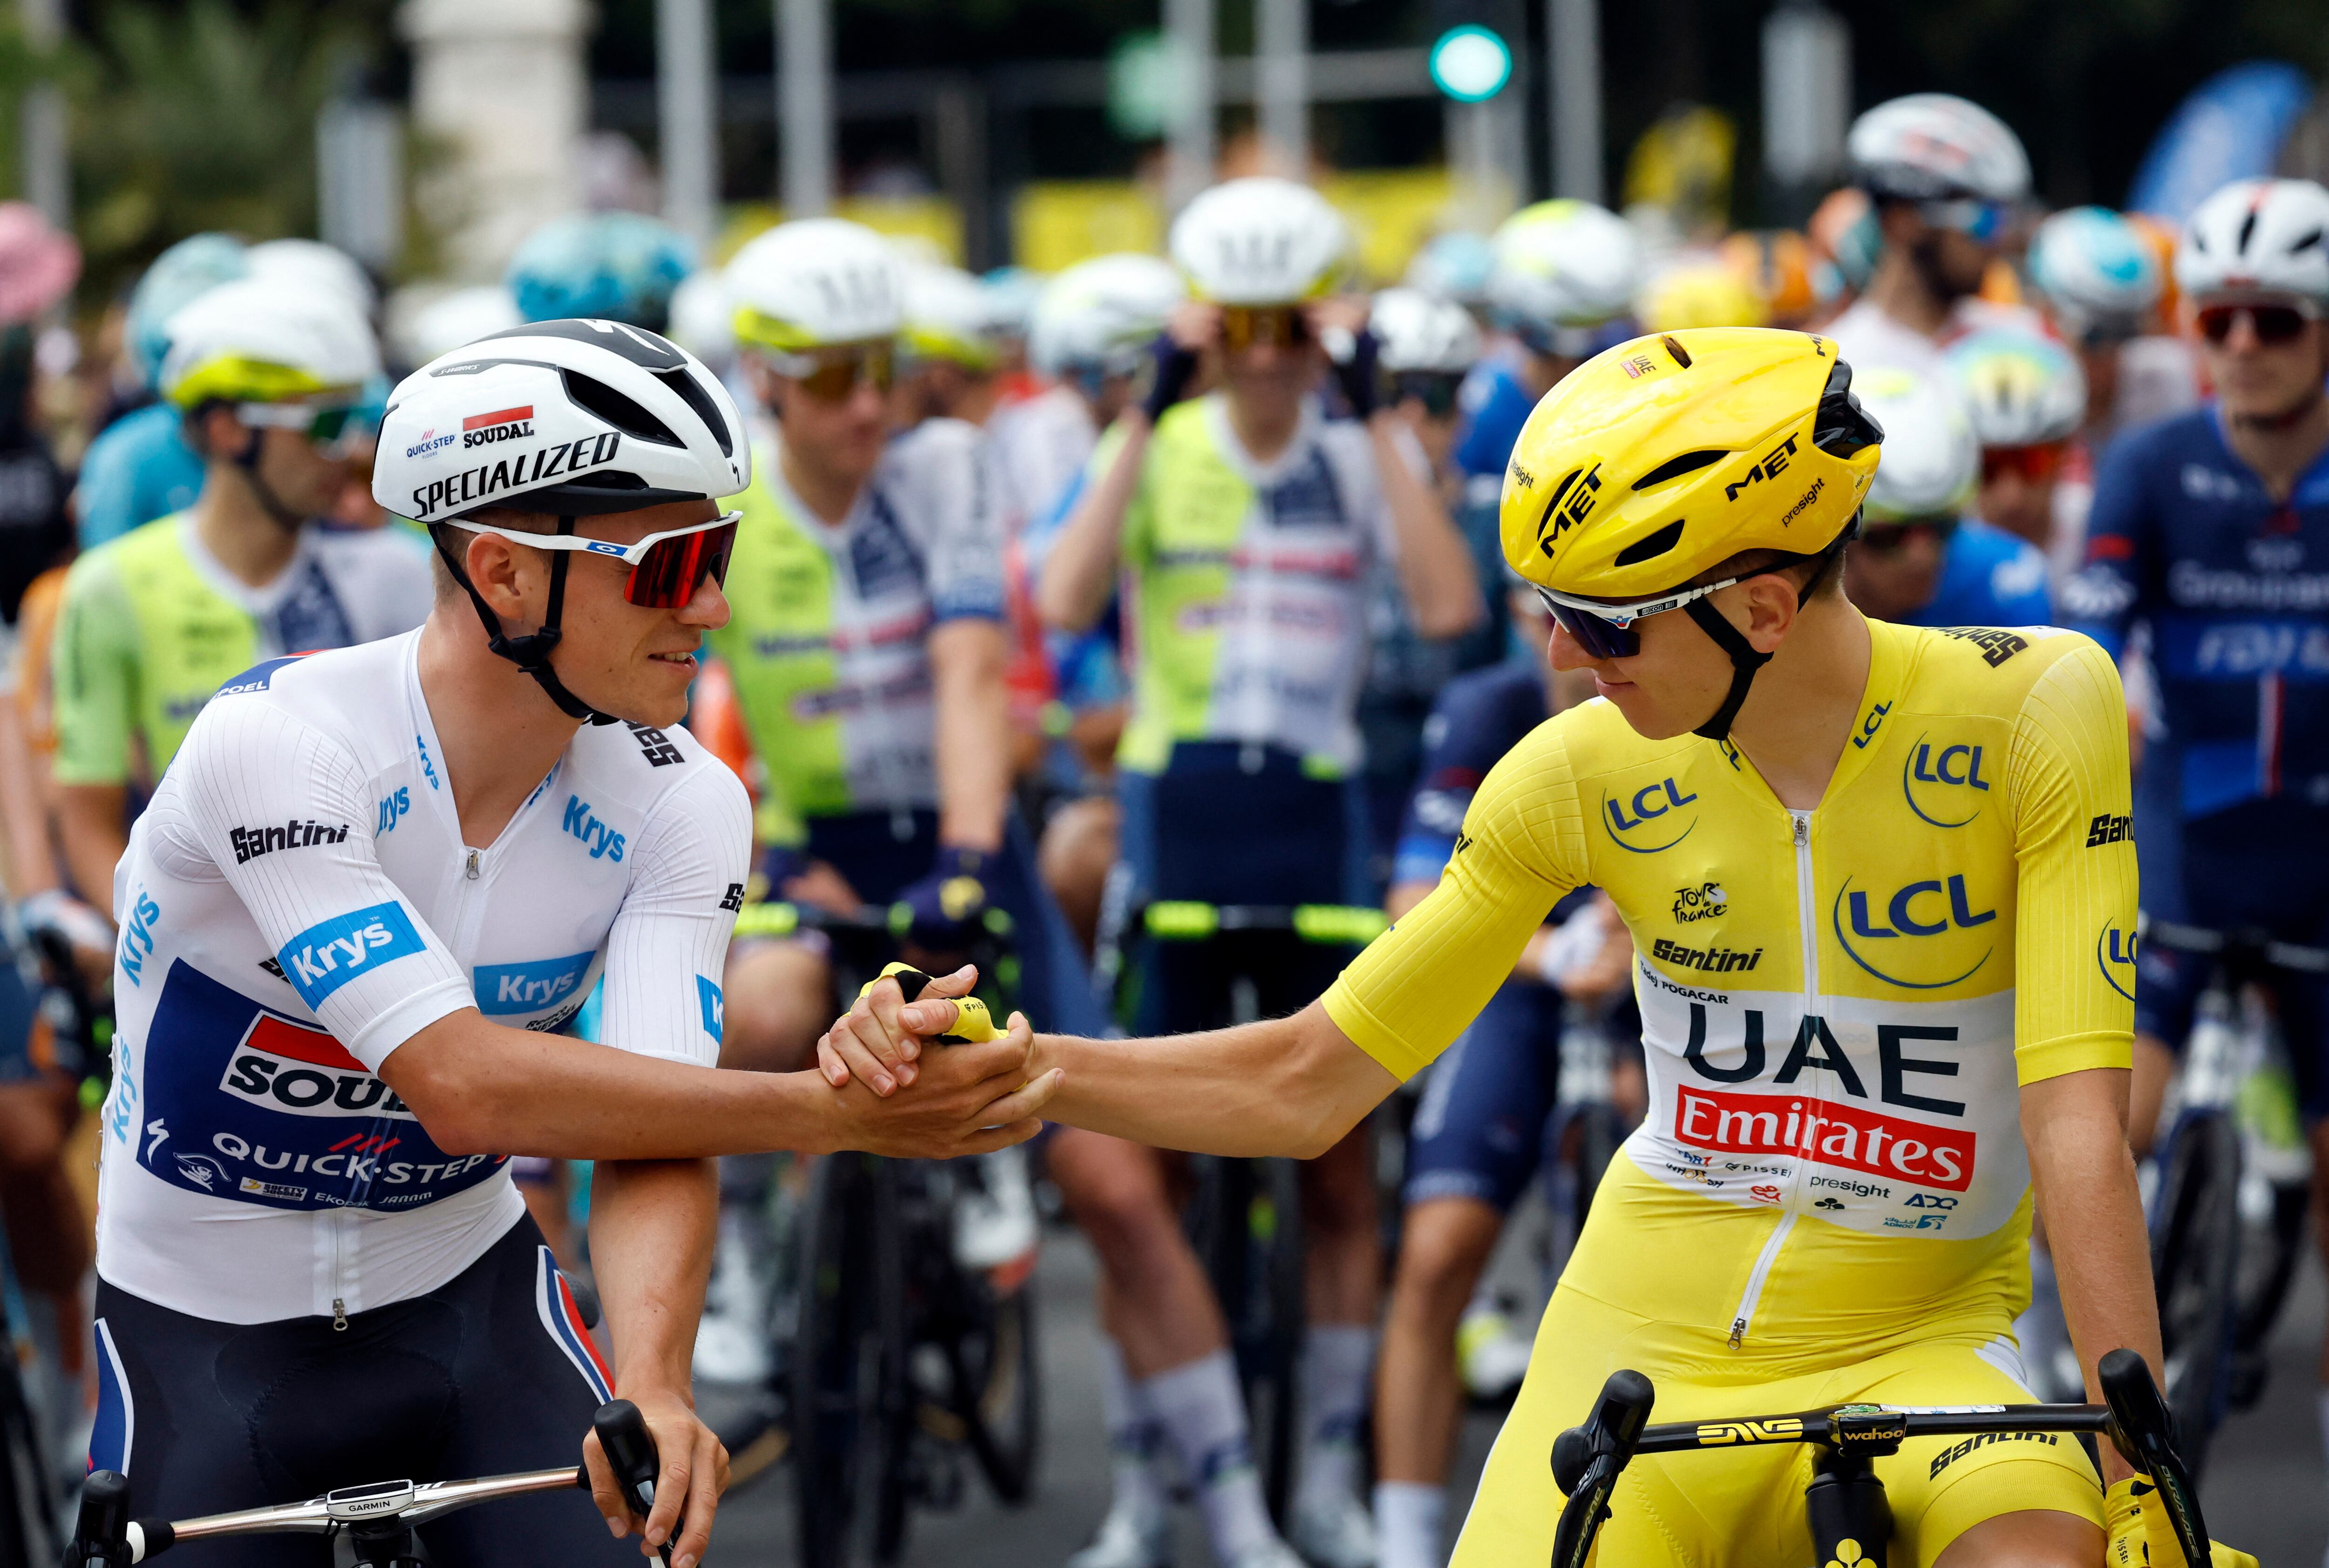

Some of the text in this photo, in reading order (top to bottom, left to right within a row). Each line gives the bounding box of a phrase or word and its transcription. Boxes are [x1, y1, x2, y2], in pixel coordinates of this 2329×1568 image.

[438, 364, 480, 375] S-WORKS
[1633, 355, 1656, 374] UAE
[463, 422, 534, 449] SOUDAL
[413, 431, 620, 518] SPECIALIZED
[1724, 432, 1798, 502] MET
[1855, 474, 1865, 490] Mips
[1540, 462, 1601, 559] MET
[1782, 477, 1825, 528] presight
[1853, 700, 1893, 749] LCL
[1914, 744, 1989, 791] LCL
[1607, 777, 1697, 831] LCL
[230, 819, 349, 865] Santini
[563, 794, 626, 863] Krys
[1849, 874, 1996, 937] LCL
[120, 892, 159, 988] Krys
[292, 923, 393, 987] Krys
[1653, 939, 1763, 972] Santini
[498, 972, 575, 1003] Krys
[1640, 960, 1728, 1004] Tadej POGACAR
[228, 1055, 408, 1111] SOU
[1683, 1002, 1966, 1117] UAE
[112, 1035, 136, 1144] Krys
[1682, 1094, 1962, 1182] Emirates
[1743, 1165, 1791, 1178] PISSEI
[1810, 1176, 1891, 1198] presight
[1903, 1193, 1958, 1210] ADQ
[1845, 1428, 1903, 1440] wahoo
[349, 1500, 390, 1512] GARMIN
[2161, 1466, 2200, 1559] DURA-ACE
[2116, 1539, 2128, 1564] PISSEI
